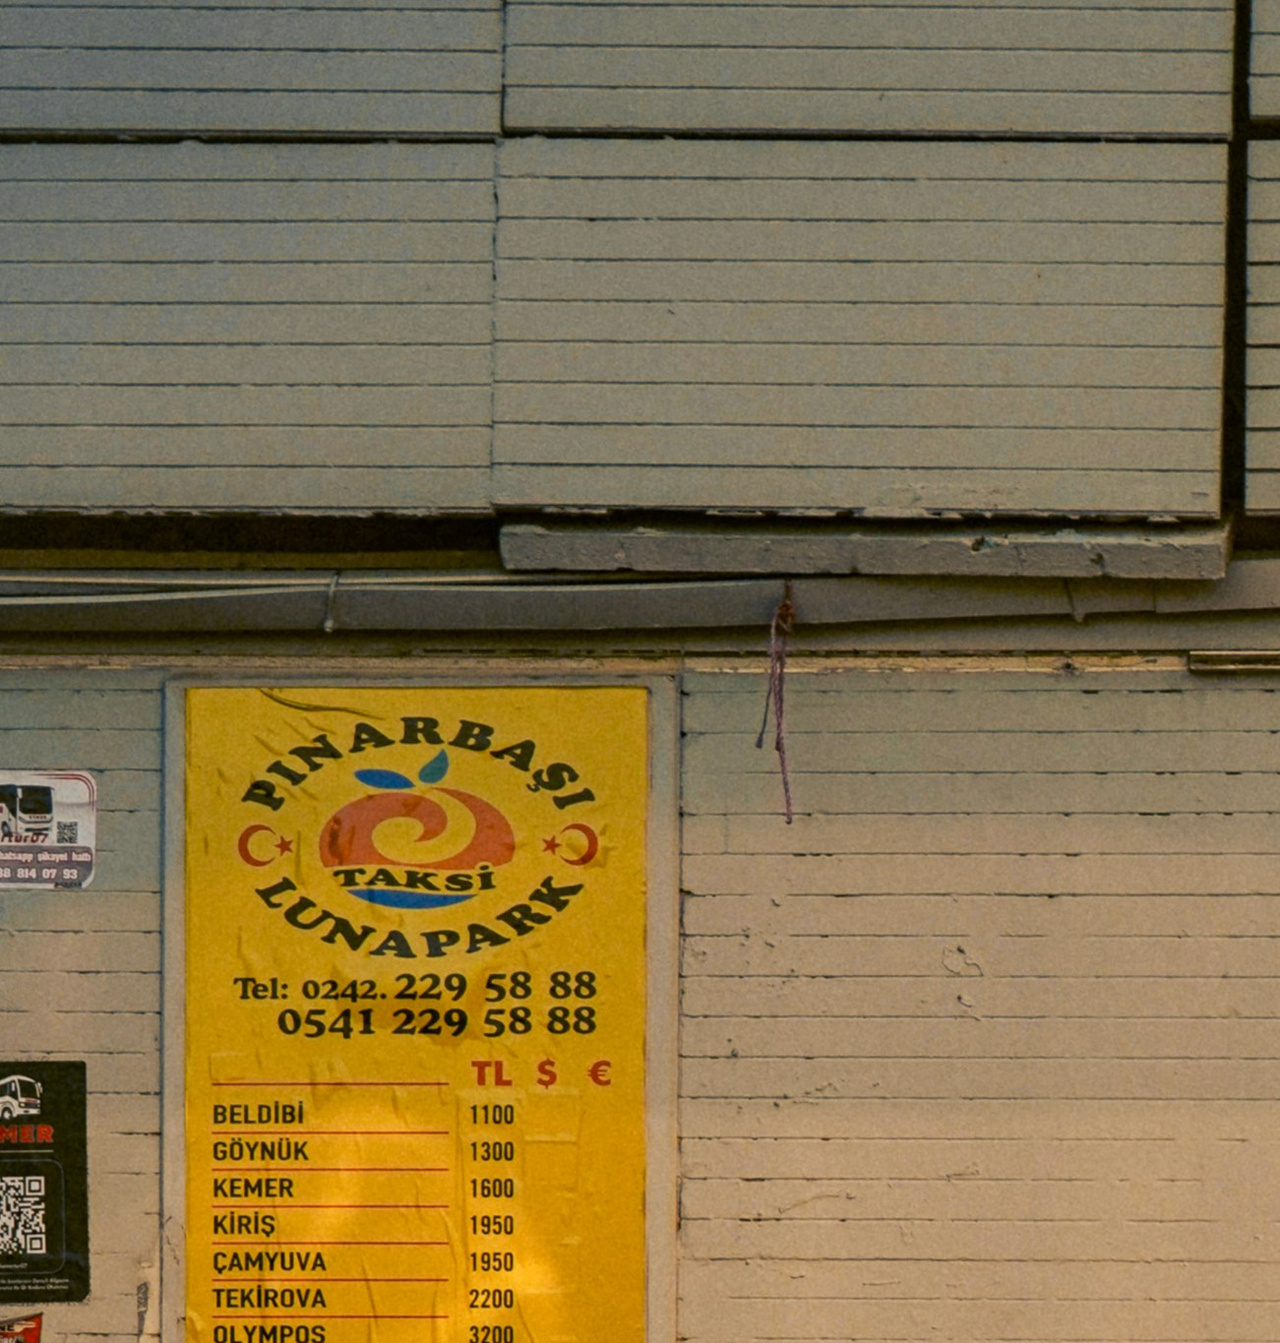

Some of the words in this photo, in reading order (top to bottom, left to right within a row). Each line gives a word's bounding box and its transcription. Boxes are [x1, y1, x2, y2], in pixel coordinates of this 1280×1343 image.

[241, 717, 596, 811] PINARBAŞI
[17, 868, 37, 879] 814
[42, 868, 57, 879] 07
[62, 868, 78, 879] 93
[333, 865, 496, 892] TAKSİ
[255, 876, 584, 958] LUNAPARK
[234, 978, 289, 1000] Tel:
[484, 971, 532, 1003] 58
[549, 971, 597, 1000] 88
[277, 1008, 375, 1039] 0541
[392, 1008, 468, 1037] 229
[483, 1007, 532, 1038] 58
[546, 1006, 597, 1035] 88
[472, 1061, 513, 1087] TL
[536, 1058, 558, 1090] $
[587, 1061, 612, 1086] €
[213, 1101, 304, 1124] BELDİBİ
[471, 1105, 514, 1124] 1100
[213, 1139, 309, 1161] GÖYNÜK
[471, 1142, 514, 1161] 1300
[213, 1178, 293, 1198] KEMER
[471, 1178, 514, 1198] 1600
[213, 1212, 275, 1237] KİRİŞ
[471, 1215, 514, 1235] 1950
[213, 1252, 326, 1274] ÇAMYUVA
[471, 1252, 514, 1272] 1950
[213, 1285, 327, 1308] TEKİROVA
[469, 1289, 514, 1309] 2200
